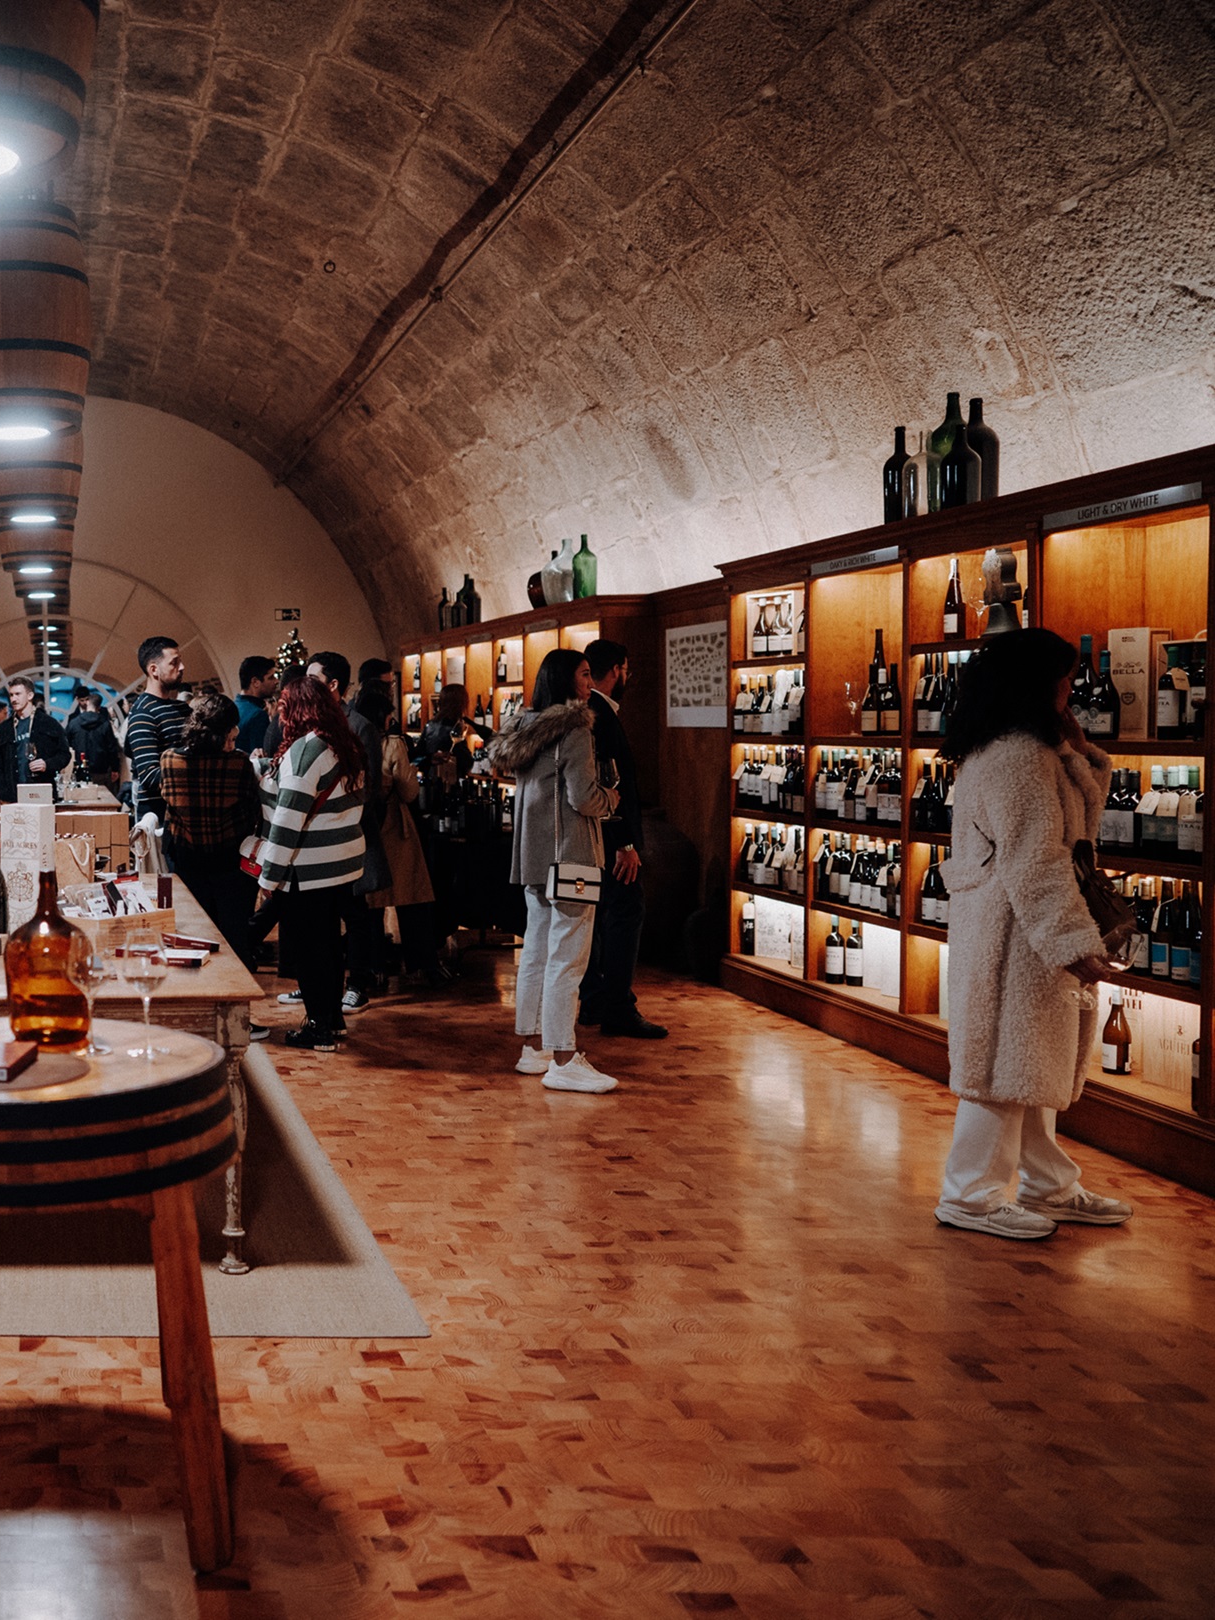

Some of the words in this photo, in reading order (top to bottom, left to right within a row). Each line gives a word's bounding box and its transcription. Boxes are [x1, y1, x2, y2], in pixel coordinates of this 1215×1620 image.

[1078, 507, 1101, 520] LIGHT
[1102, 505, 1108, 514] &
[1111, 501, 1128, 513] DRY
[1130, 494, 1159, 509] WHITE
[861, 553, 876, 563] WHITE
